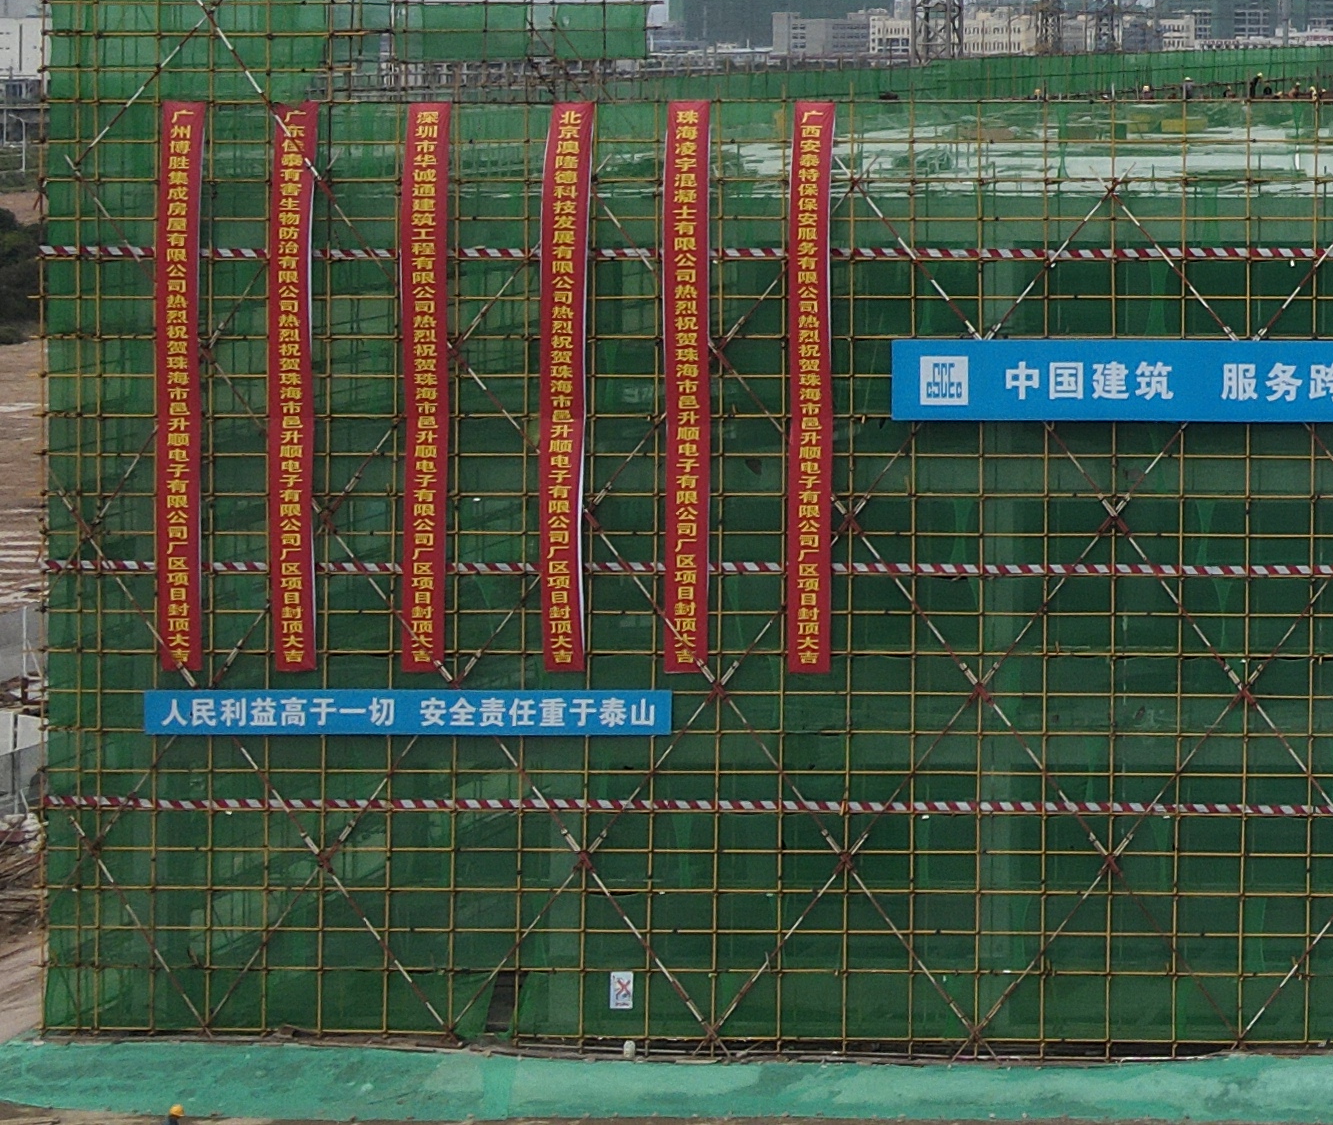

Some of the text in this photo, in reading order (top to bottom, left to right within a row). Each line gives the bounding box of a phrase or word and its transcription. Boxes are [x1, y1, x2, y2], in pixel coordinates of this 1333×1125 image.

[1005, 361, 1174, 400] 中国建筑
[162, 698, 656, 728] 人民利益高于一切 安全责任重于泰山
